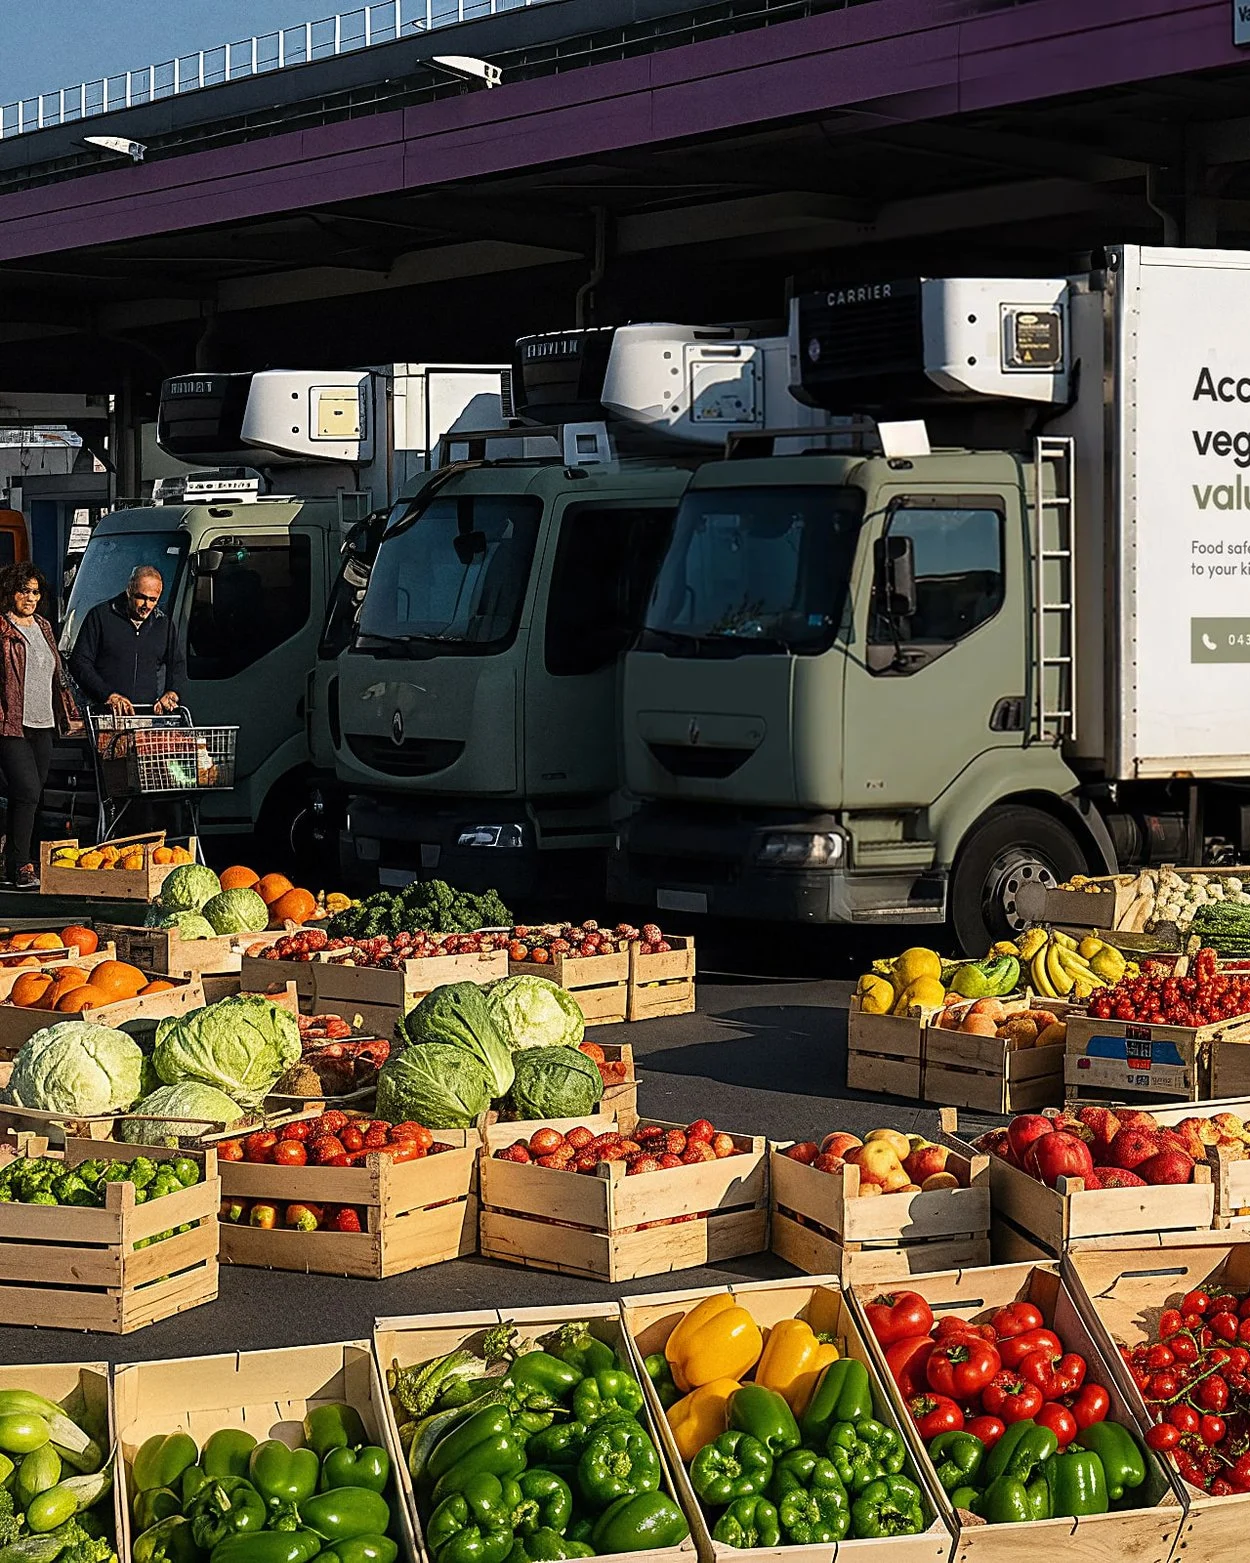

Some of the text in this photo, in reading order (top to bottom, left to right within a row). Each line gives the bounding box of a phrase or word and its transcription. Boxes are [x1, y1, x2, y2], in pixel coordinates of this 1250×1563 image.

[827, 284, 892, 306] CARRIER
[1191, 540, 1223, 555] Food
[1191, 562, 1205, 576] to
[1208, 565, 1238, 580] your
